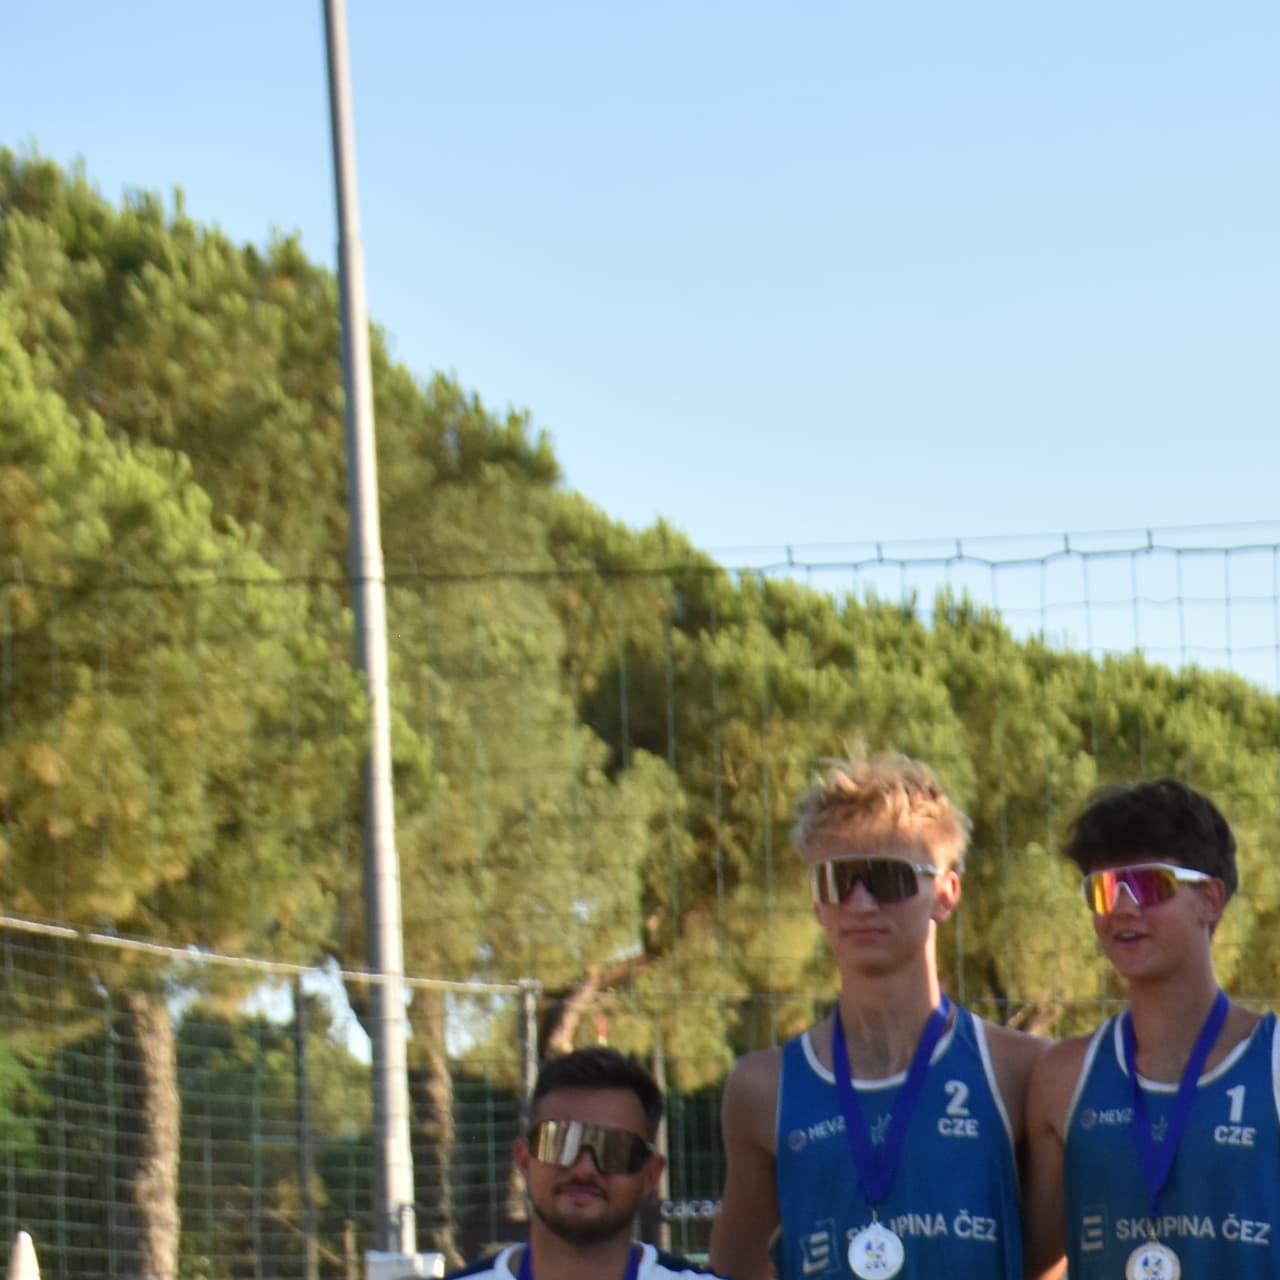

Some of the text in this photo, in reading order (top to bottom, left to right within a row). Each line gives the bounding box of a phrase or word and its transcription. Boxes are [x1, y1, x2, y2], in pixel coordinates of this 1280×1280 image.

[943, 1080, 970, 1116] 2
[1226, 1084, 1246, 1122] 1
[937, 1118, 979, 1138] CZE
[1214, 1125, 1257, 1147] CZE
[846, 1212, 948, 1240] SPINA
[953, 1208, 998, 1242] ČEZ
[1116, 1215, 1215, 1240] SKUPINA
[1221, 1213, 1272, 1245] ČEZ
